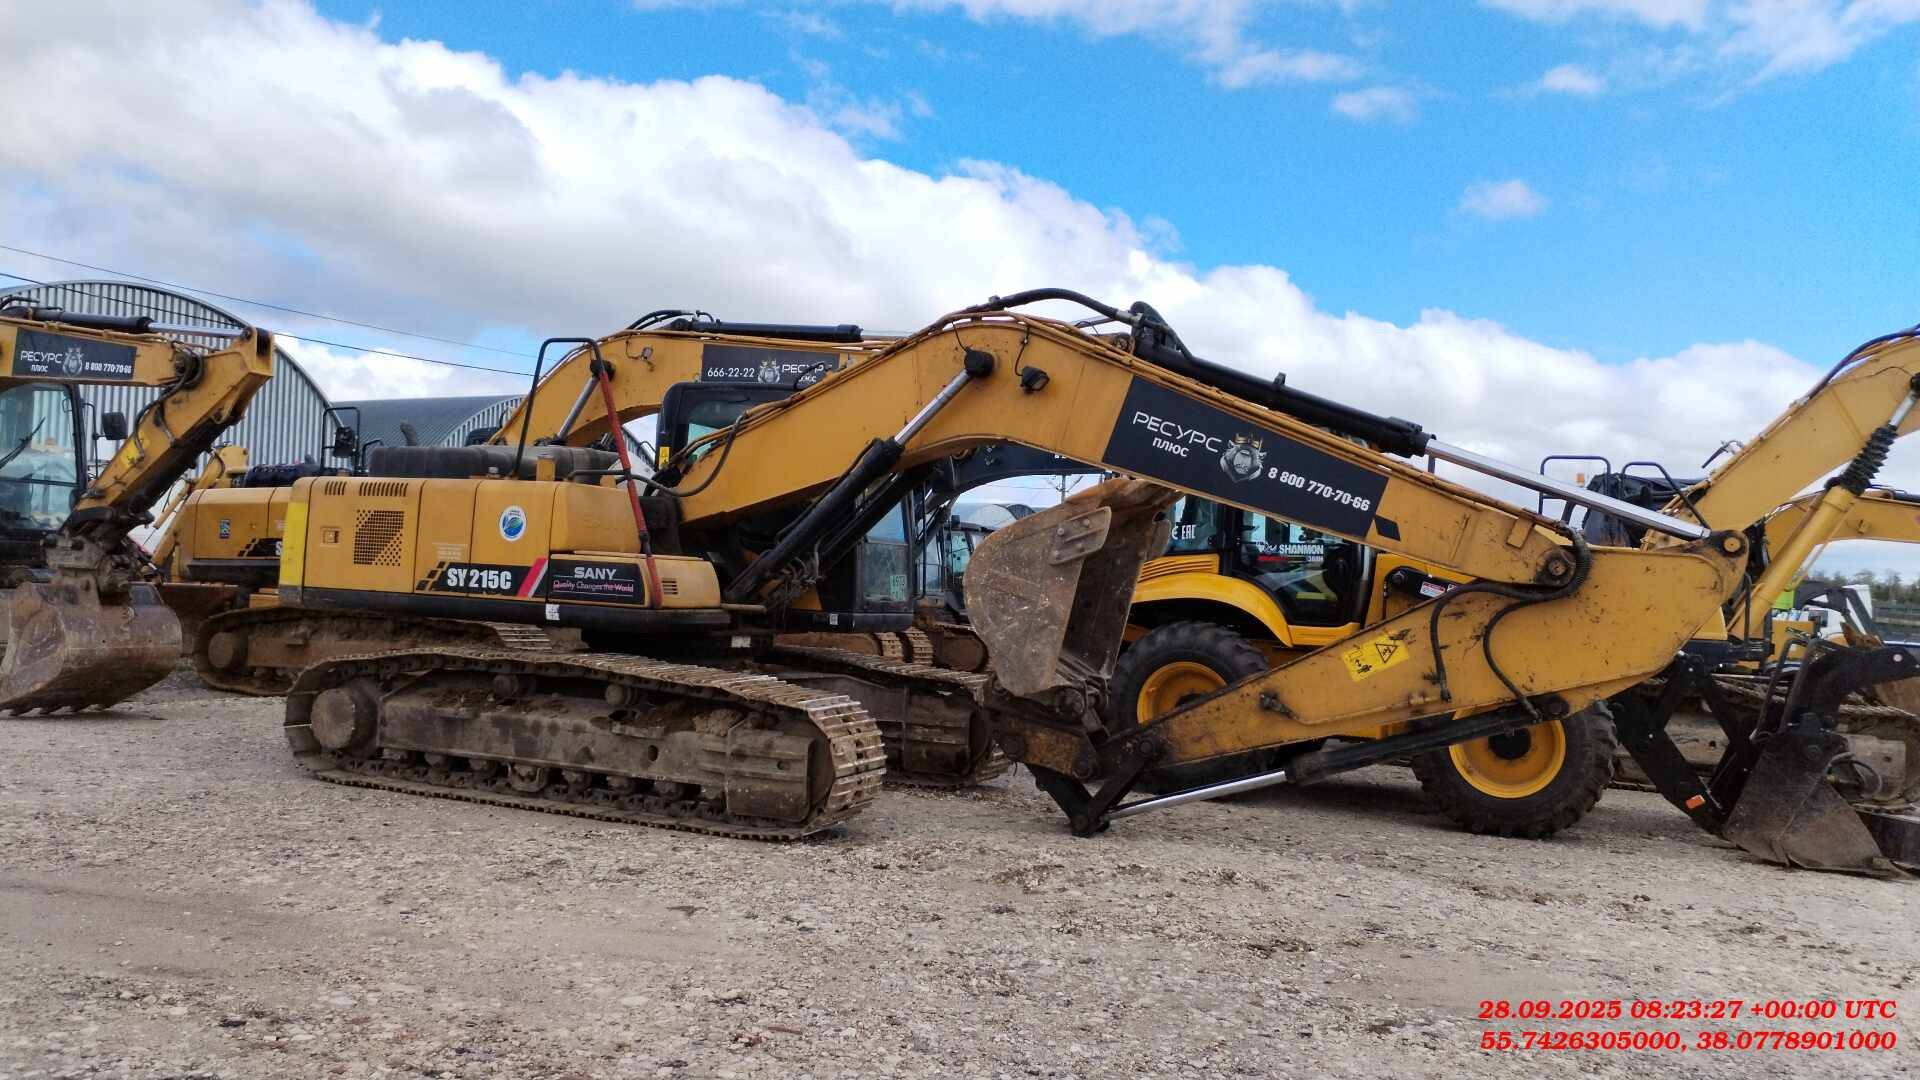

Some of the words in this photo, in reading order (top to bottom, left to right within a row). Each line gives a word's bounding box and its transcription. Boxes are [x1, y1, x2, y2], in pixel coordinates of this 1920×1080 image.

[20, 350, 63, 364] РЕСУРС
[706, 367, 755, 378] 666-22-22
[1132, 411, 1222, 453] РЕСУРС
[1267, 467, 1278, 479] 8
[1279, 471, 1306, 488] 800
[1307, 480, 1371, 511] 770-70-66
[574, 566, 617, 580] SANY
